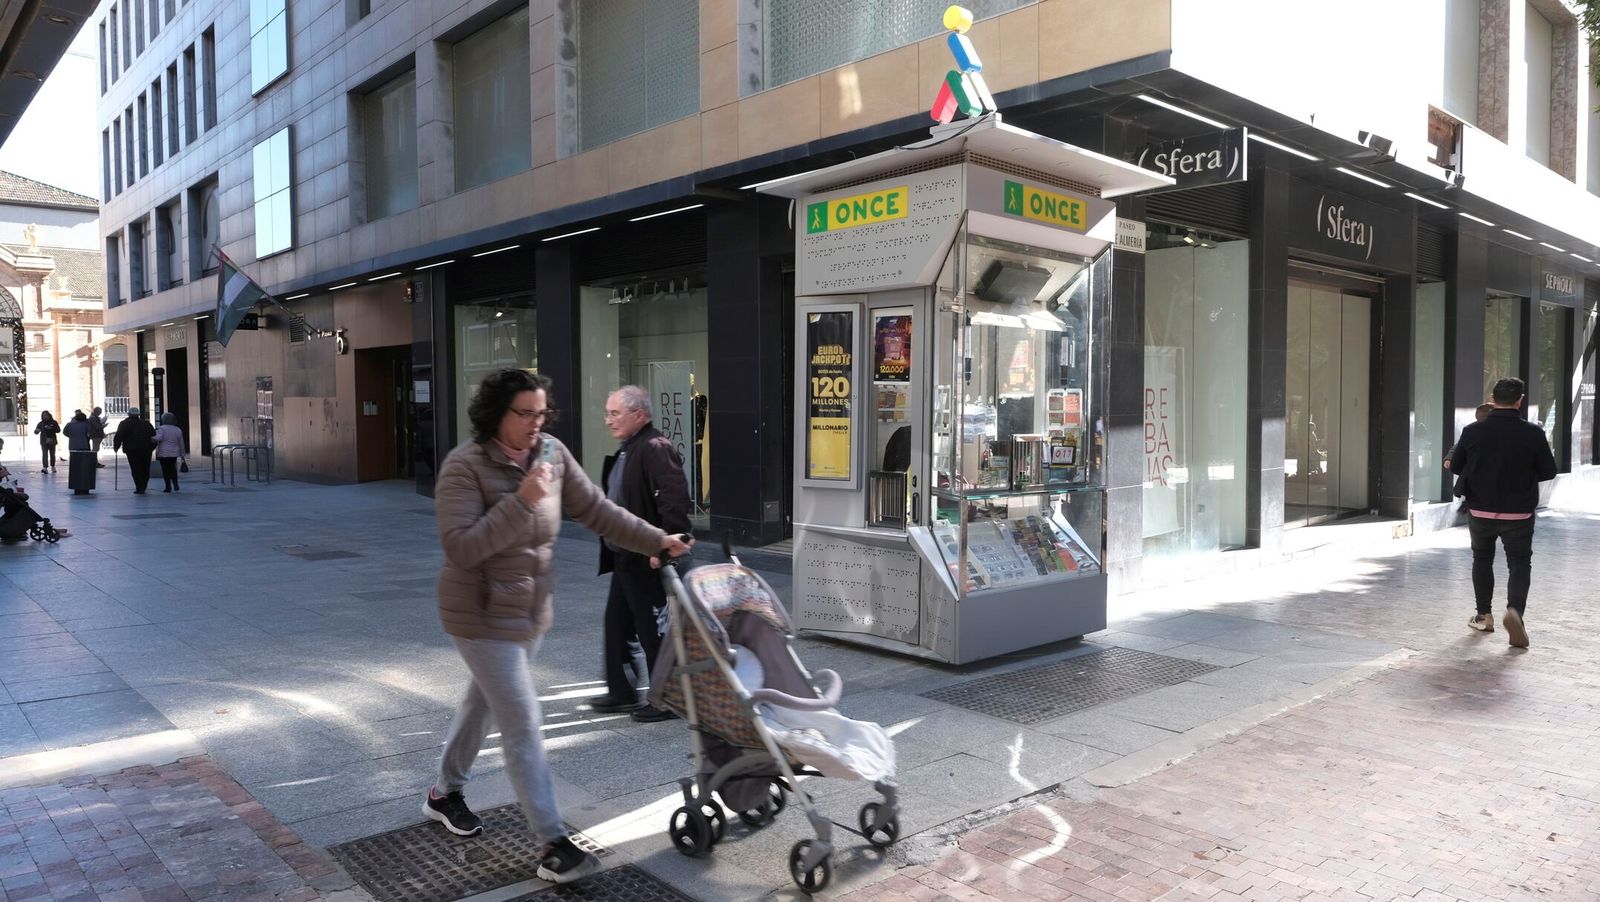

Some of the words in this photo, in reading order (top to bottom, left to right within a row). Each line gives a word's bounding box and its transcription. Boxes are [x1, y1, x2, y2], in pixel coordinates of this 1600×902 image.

[836, 192, 900, 224] ONCE
[1029, 193, 1080, 224] ONCE
[1119, 222, 1135, 230] PASEO
[1545, 273, 1573, 294] SEPHORA
[811, 377, 850, 397] 120
[660, 392, 682, 415] RE
[812, 398, 849, 406] MILLONES
[1145, 388, 1168, 420] RE
[661, 417, 684, 440] BA
[1145, 422, 1170, 454] BA
